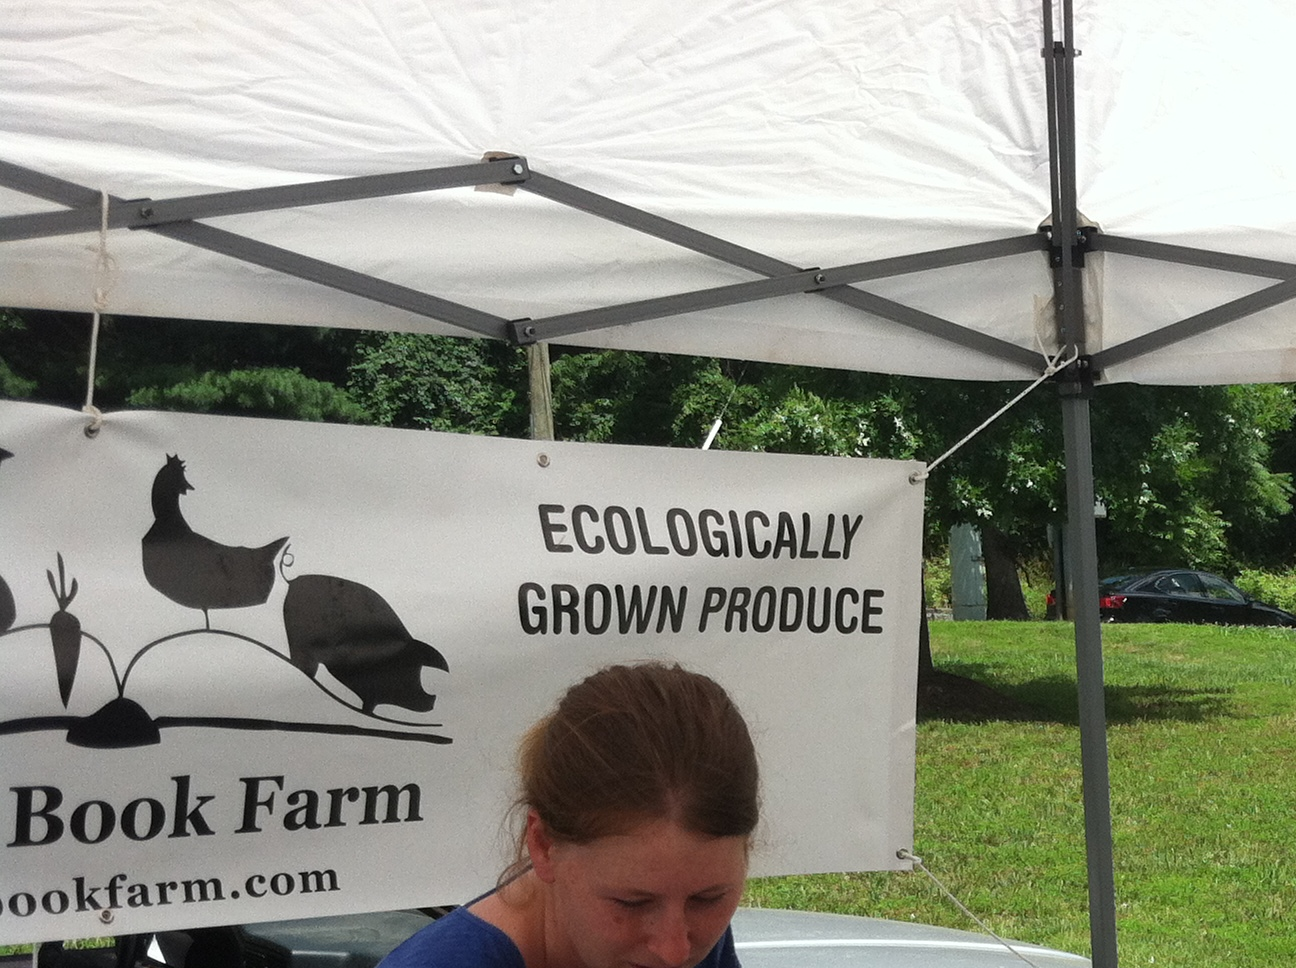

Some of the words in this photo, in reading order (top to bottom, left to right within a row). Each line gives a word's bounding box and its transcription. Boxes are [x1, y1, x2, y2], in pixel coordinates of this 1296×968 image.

[538, 504, 863, 560] ECOLOGICALLY
[518, 582, 688, 635] GROWN
[698, 586, 884, 635] PRODUCE
[7, 774, 216, 848] Book
[234, 774, 424, 835] Farm
[0, 867, 341, 919] ookfarm.com
